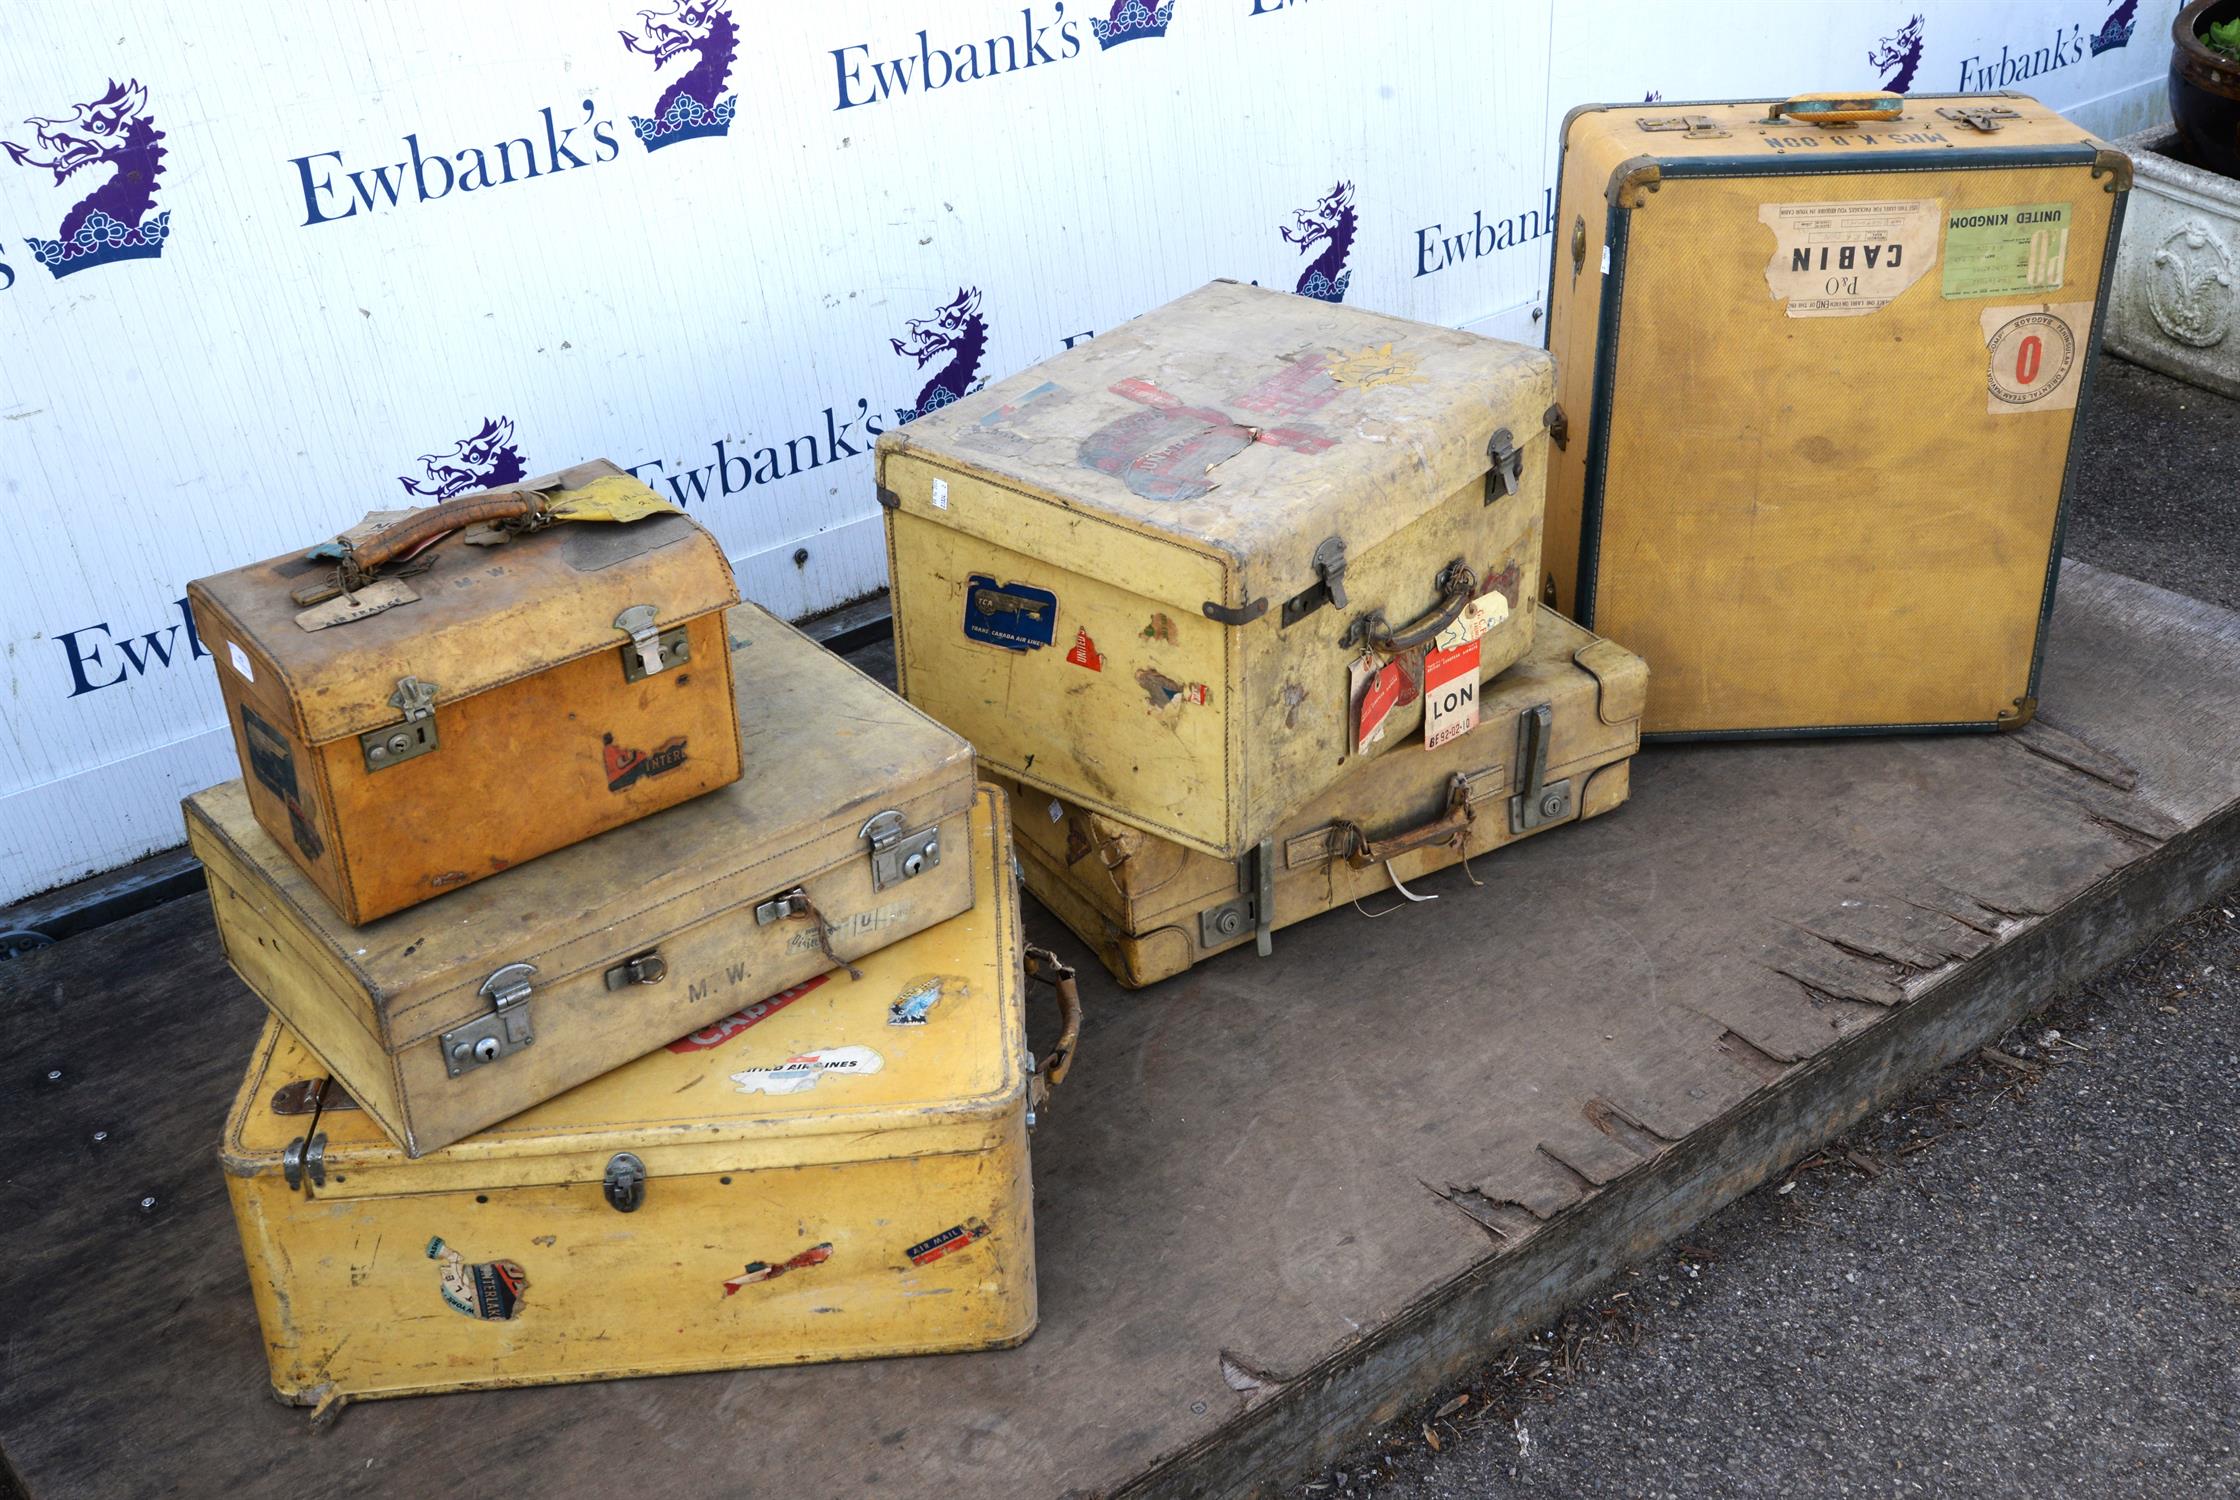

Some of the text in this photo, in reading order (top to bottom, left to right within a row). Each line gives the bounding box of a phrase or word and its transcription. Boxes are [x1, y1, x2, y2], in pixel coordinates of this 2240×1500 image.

[827, 1, 1081, 112] Ewbank's
[287, 99, 620, 227] Ewbank's
[1950, 210, 2061, 229] UNITED KINGDOM
[1792, 244, 1903, 272] CABIN
[1825, 276, 1858, 296] P&O
[1816, 301, 1829, 309] END
[2014, 316, 2053, 328] BAGGAGE
[2056, 324, 2071, 365] PENINSULAR
[2003, 393, 2027, 401] STEAM
[2029, 374, 2061, 399] ORIENTAL
[325, 616, 347, 627] AIR
[991, 630, 1015, 640] CANADA
[1016, 635, 1026, 643] AIR
[1076, 636, 1087, 663] UNITED
[1433, 683, 1473, 720] LON
[913, 1229, 958, 1255] AIR MAIL
